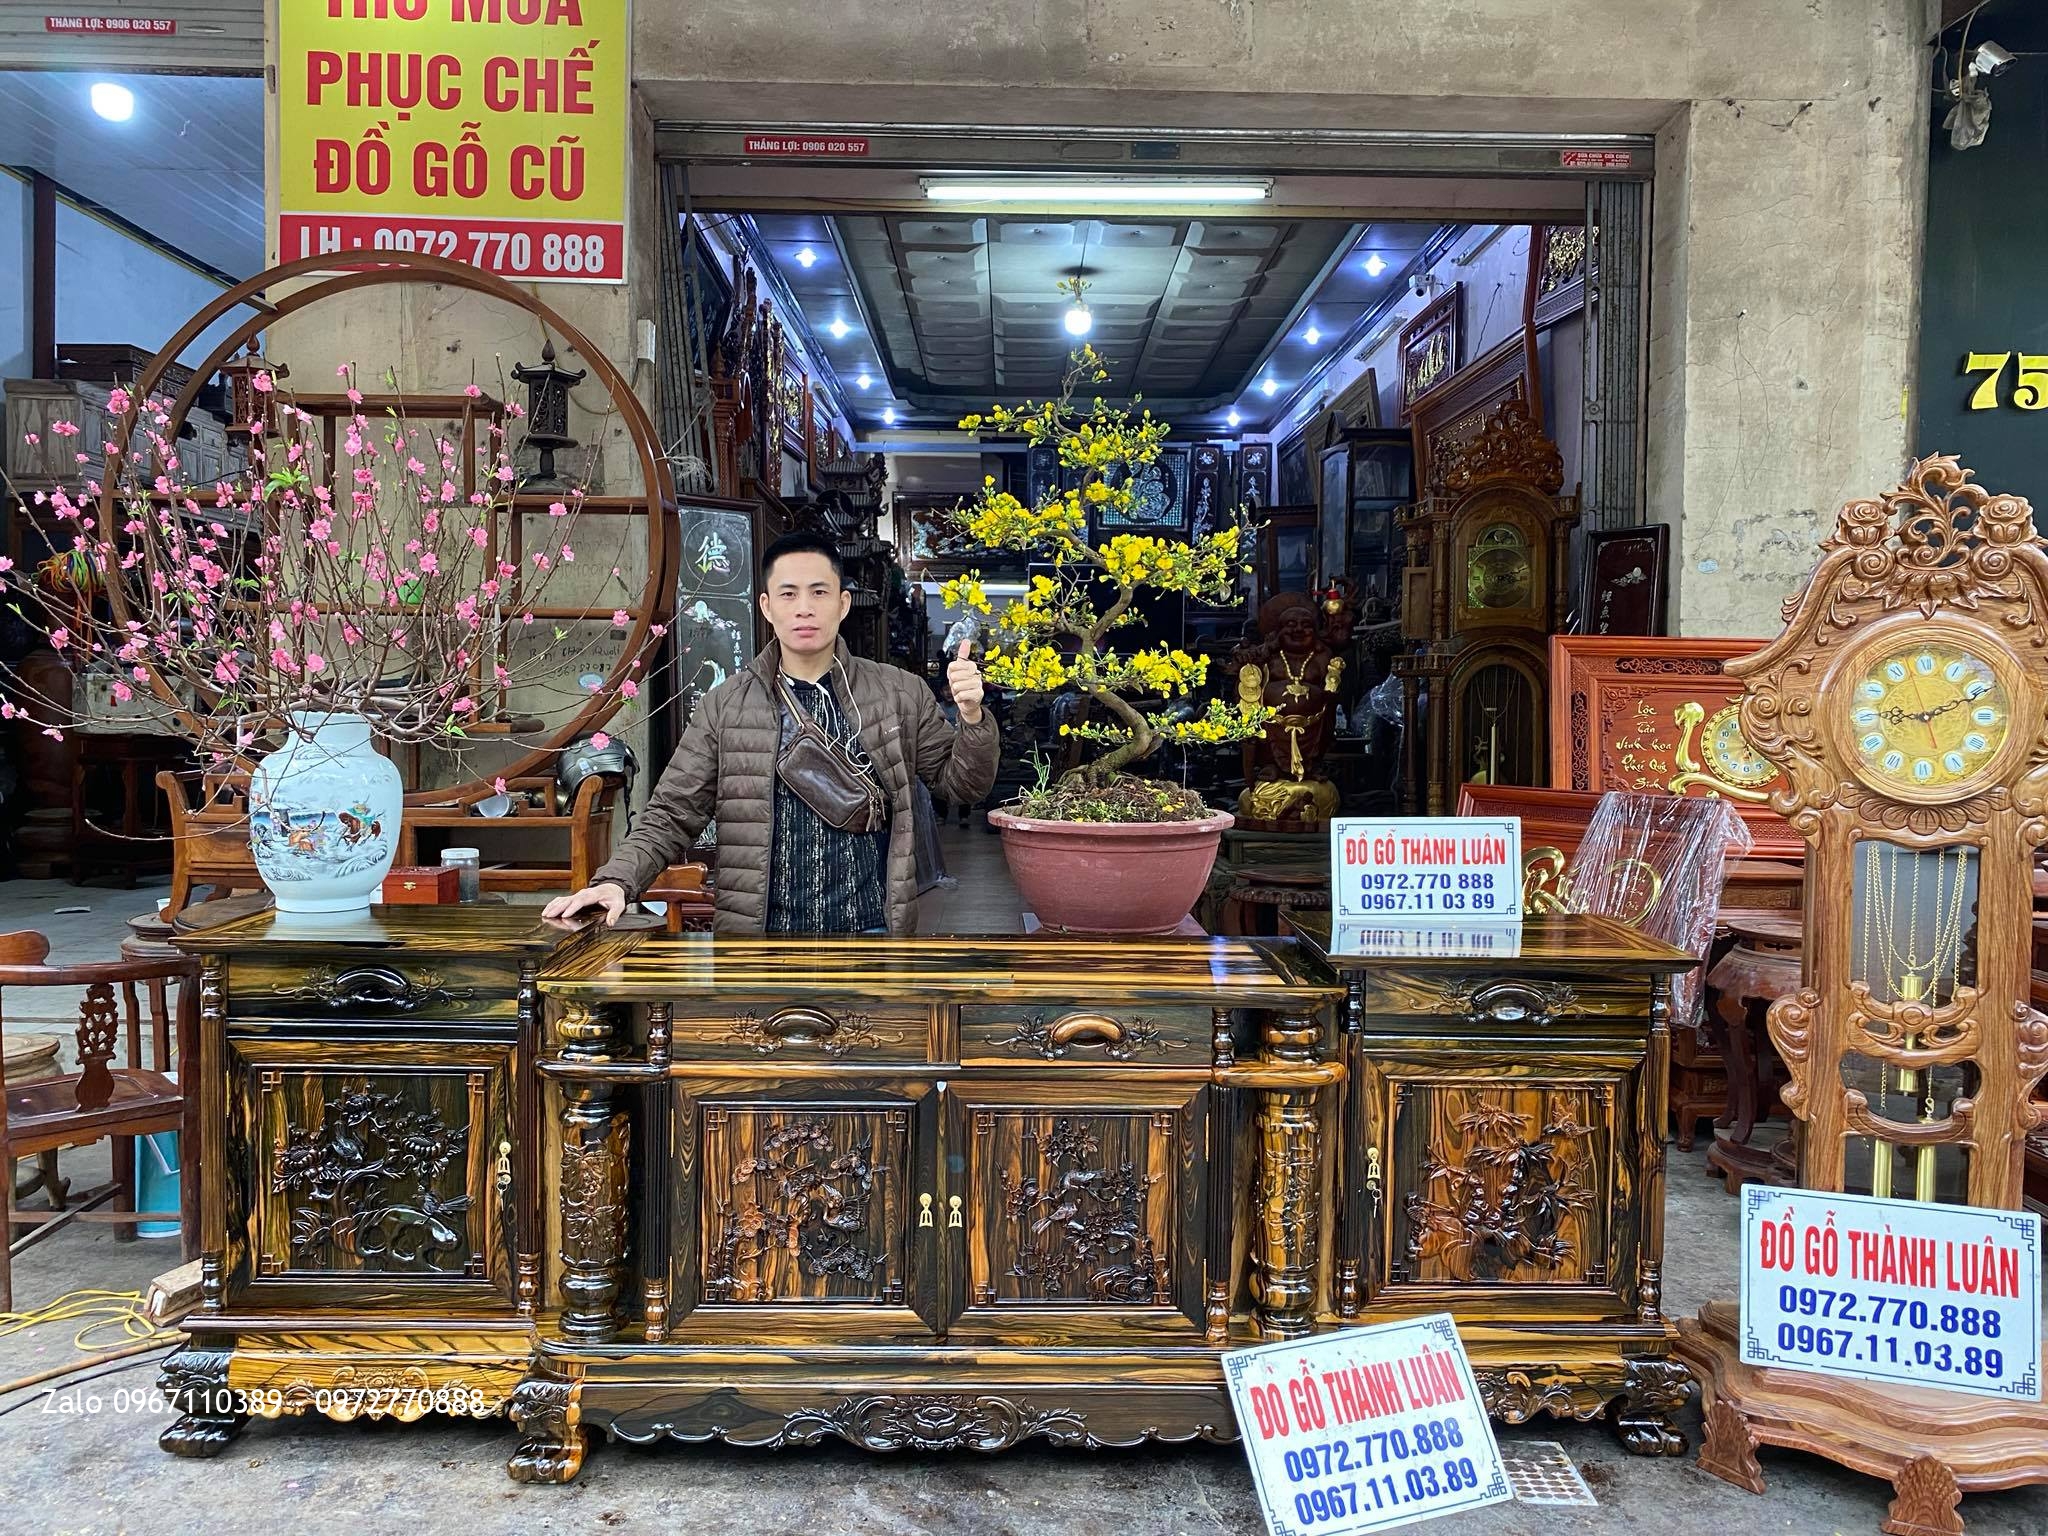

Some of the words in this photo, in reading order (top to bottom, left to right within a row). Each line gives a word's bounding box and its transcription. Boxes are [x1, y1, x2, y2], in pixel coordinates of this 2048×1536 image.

[106, 19, 130, 29] 0906
[133, 19, 150, 30] 020
[153, 20, 171, 30] 557
[307, 50, 461, 121] PHỤC
[484, 40, 600, 114] CHẾ
[314, 121, 391, 195] ĐỒ
[413, 121, 488, 198] GỖ
[510, 135, 585, 201] CŨ
[803, 141, 825, 151] 0906
[828, 142, 845, 151] 020
[848, 143, 864, 152] 557
[543, 234, 604, 273] 888
[1346, 830, 1368, 865] ĐỒ
[1374, 828, 1395, 865] GỖ
[1401, 833, 1456, 865] THÀNH
[1462, 833, 1506, 865] LUÂN
[1361, 873, 1451, 890] 0972.770
[1458, 873, 1494, 890] 888
[1361, 893, 1434, 910] 0967.11
[1442, 893, 1465, 910] 03
[1472, 893, 1495, 909] 89
[1760, 1206, 1796, 1273] ĐỒ
[1804, 1210, 1839, 1278] GỖ
[1848, 1224, 1937, 1289] THÀNH
[1946, 1235, 2020, 1299] LUÂN
[1779, 1285, 2002, 1339] 0972.770.888
[1778, 1322, 2004, 1379] 0967.11.03.89
[1289, 1358, 1326, 1433] GỖ
[1323, 1359, 1405, 1427] THÀNH
[1400, 1343, 1466, 1410] LUÂN
[1284, 1417, 1464, 1482] 0972.770.888
[1294, 1457, 1479, 1526] 0967.11.03.89
